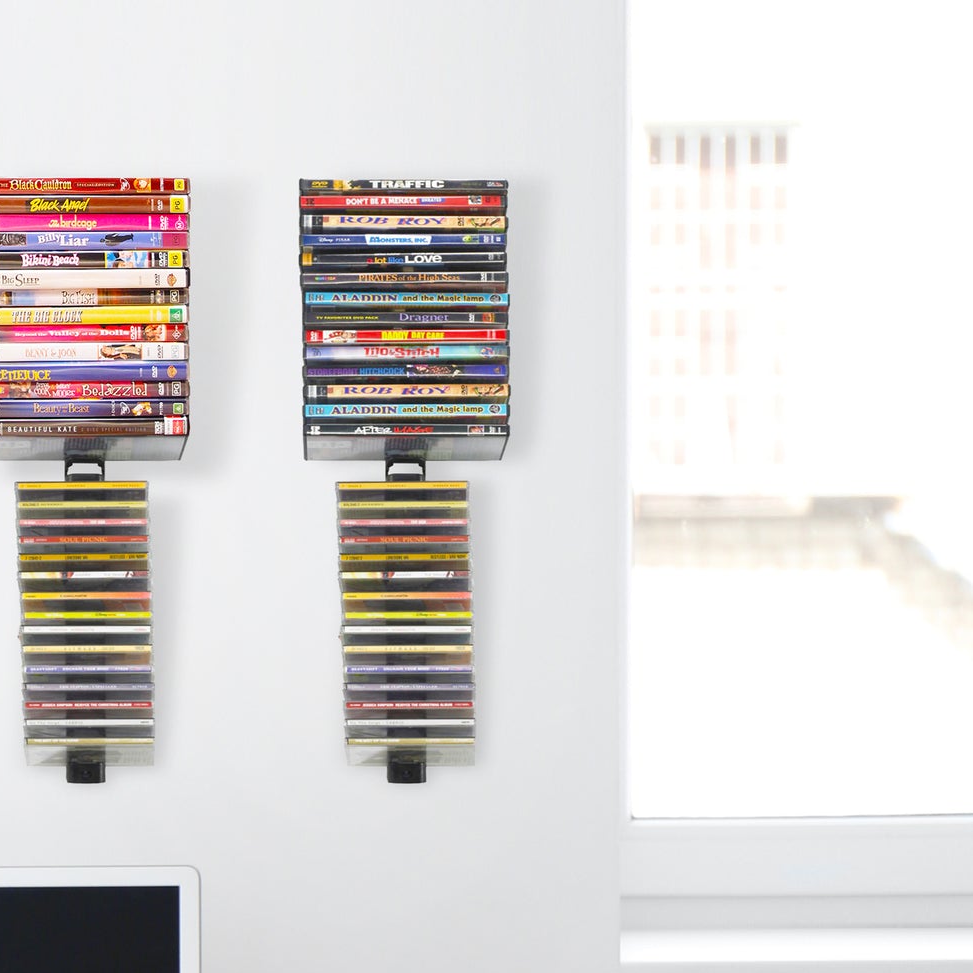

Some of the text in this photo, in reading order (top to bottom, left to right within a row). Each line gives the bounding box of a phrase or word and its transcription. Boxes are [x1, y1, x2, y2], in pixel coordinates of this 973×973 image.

[10, 179, 34, 190] Black
[34, 179, 72, 191] Cauldron
[369, 180, 445, 189] TRAFFIC
[29, 198, 90, 212] Black Angel
[174, 200, 181, 210] PG
[59, 214, 97, 230] birdcage
[340, 216, 447, 225] ROB ROY
[38, 232, 89, 247] Billy Liar
[20, 252, 80, 267] Bikini Beach
[173, 255, 179, 265] PG
[374, 256, 387, 264] lot
[358, 274, 398, 282] PIRATES
[418, 273, 440, 283] High
[441, 273, 460, 281] Seas
[331, 294, 398, 302] ALADDIN
[436, 295, 461, 303] Magic
[463, 295, 485, 303] lamp
[11, 310, 84, 323] THE BIG CLOCK
[399, 313, 449, 323] Dragnet
[48, 330, 80, 338] Valley
[99, 329, 130, 337] Dolls
[381, 331, 445, 340] DADDY DAY CARE
[25, 348, 48, 358] BENNY
[307, 367, 405, 376] STOREFRONT HITCHCOCK
[81, 381, 148, 397] Bedazzled
[343, 385, 450, 395] ROB ROY
[33, 402, 61, 415] Beauty
[68, 402, 90, 413] Beast
[331, 406, 398, 415] ALADDIN
[436, 406, 461, 414] Magic
[462, 406, 484, 414] lamp
[57, 425, 78, 433] KATE
